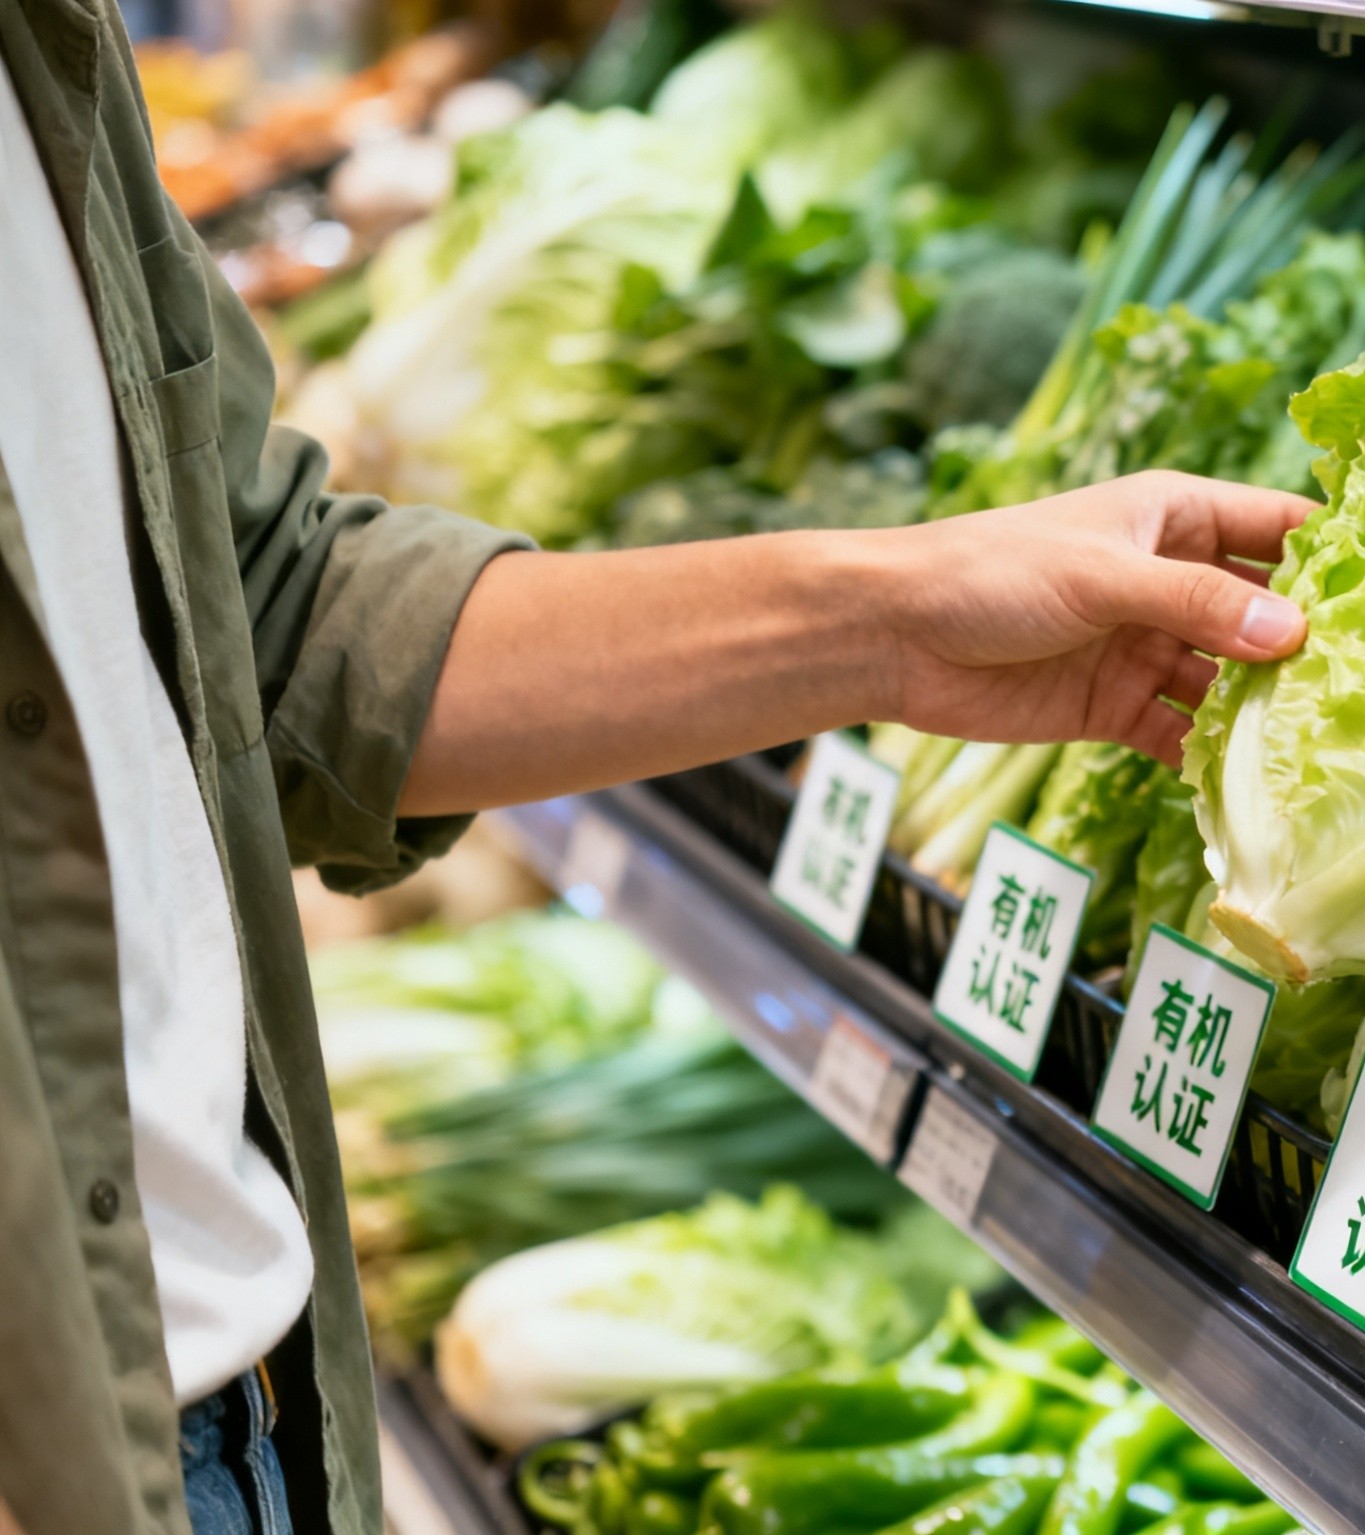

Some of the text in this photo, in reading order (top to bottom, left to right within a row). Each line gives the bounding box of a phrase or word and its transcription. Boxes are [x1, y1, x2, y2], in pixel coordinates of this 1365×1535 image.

[989, 872, 1059, 961] 有机
[968, 945, 1041, 1035] 认证
[1150, 977, 1235, 1079] 有机
[1128, 1053, 1217, 1158] 认证
